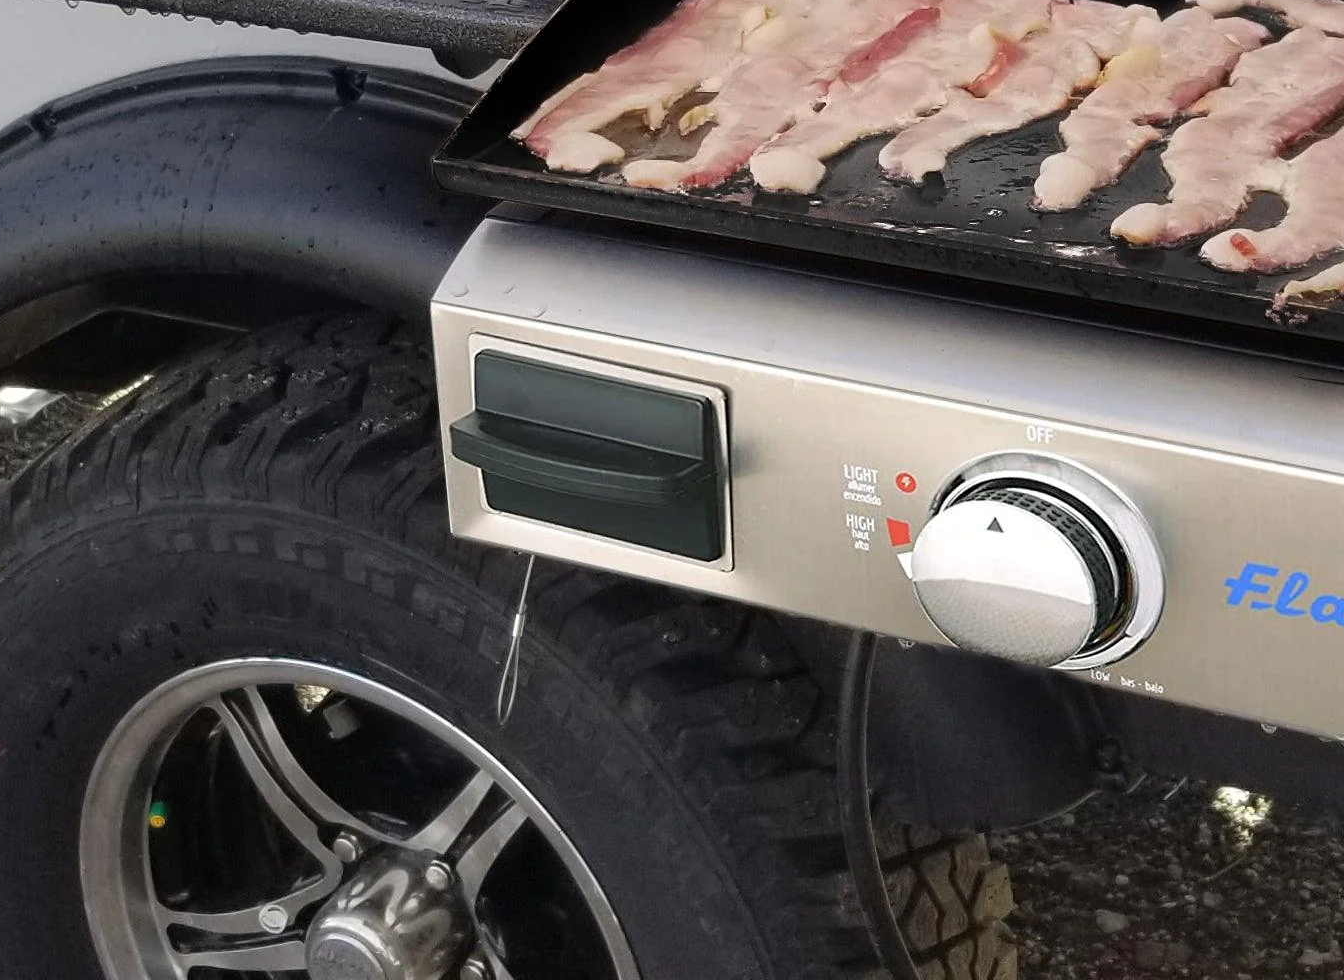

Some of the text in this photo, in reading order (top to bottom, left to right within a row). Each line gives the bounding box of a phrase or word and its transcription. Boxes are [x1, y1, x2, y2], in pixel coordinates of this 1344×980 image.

[1026, 425, 1054, 444] OFF
[843, 464, 879, 484] LIGHT
[846, 513, 875, 533] HIGH
[852, 528, 870, 541] haut
[854, 540, 870, 551] alto
[1090, 668, 1111, 681] LOW
[1120, 676, 1136, 688] bas
[1144, 680, 1164, 694] bajo
